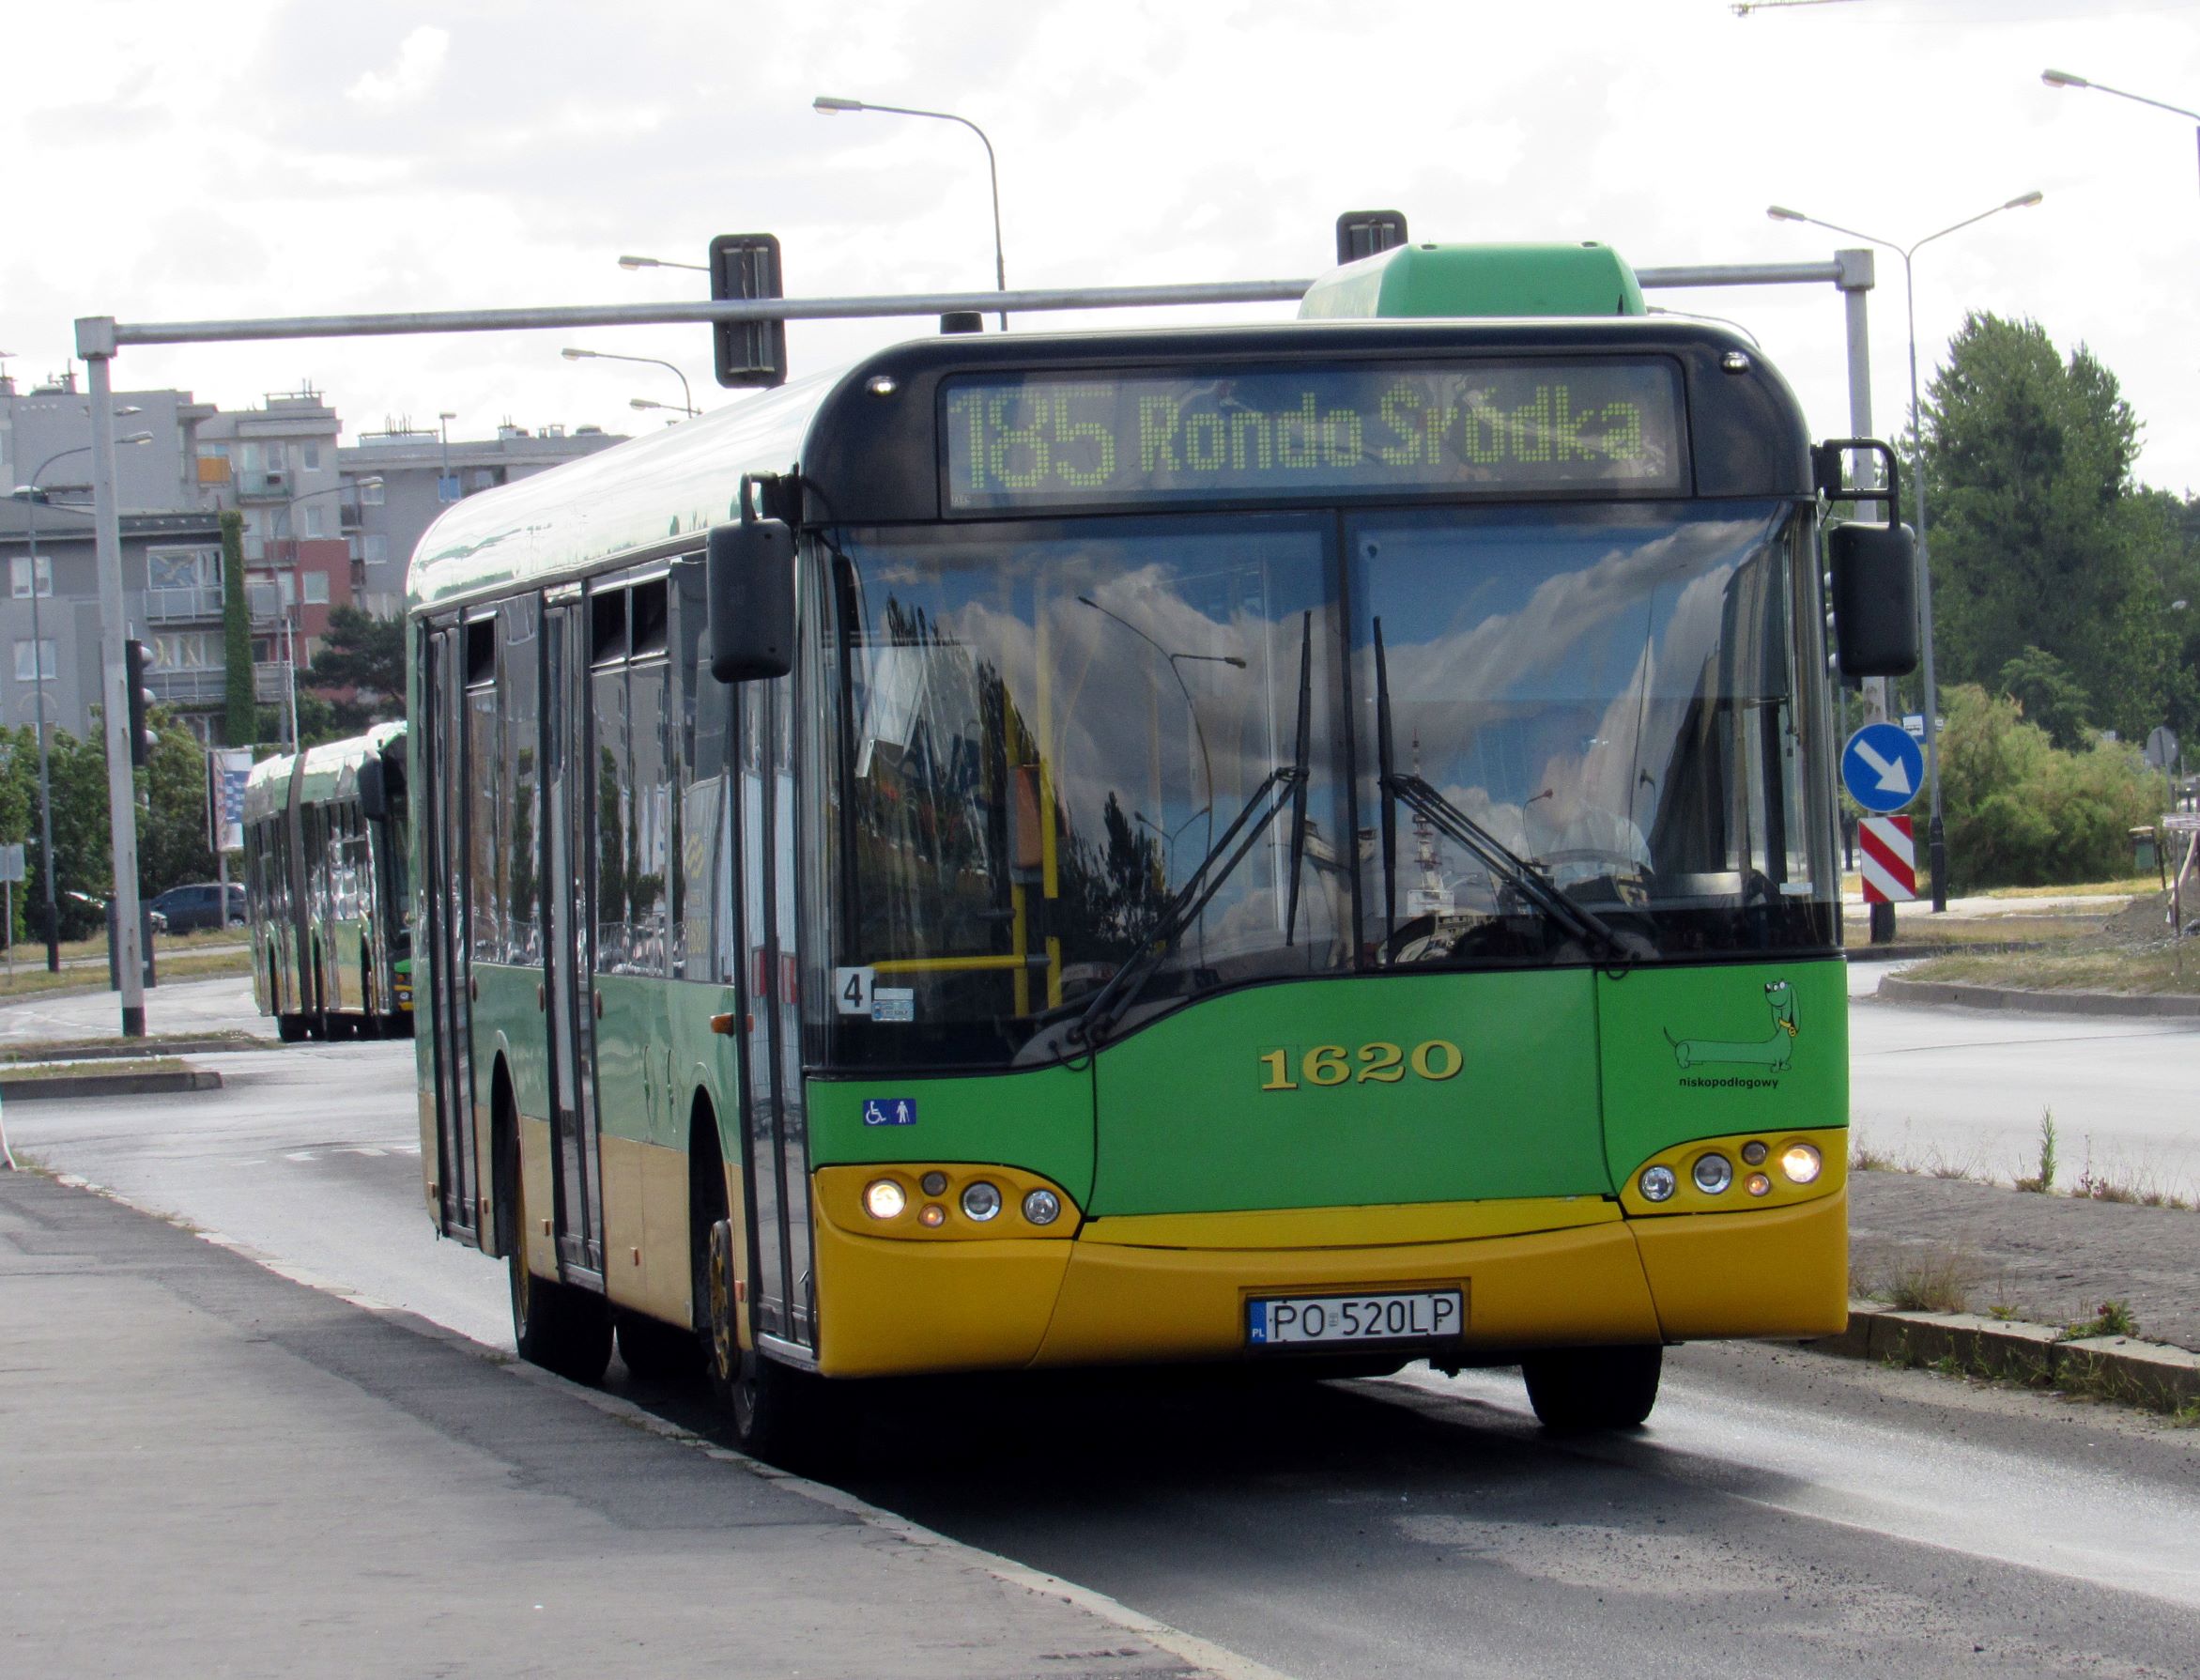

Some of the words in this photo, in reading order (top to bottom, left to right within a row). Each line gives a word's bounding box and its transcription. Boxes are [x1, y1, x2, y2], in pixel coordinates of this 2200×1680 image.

[949, 386, 1115, 488] 185
[1139, 393, 1362, 471] Rondo
[844, 973, 864, 1008] 4
[1261, 1040, 1464, 1090] 1620
[1252, 1328, 1265, 1338] PL
